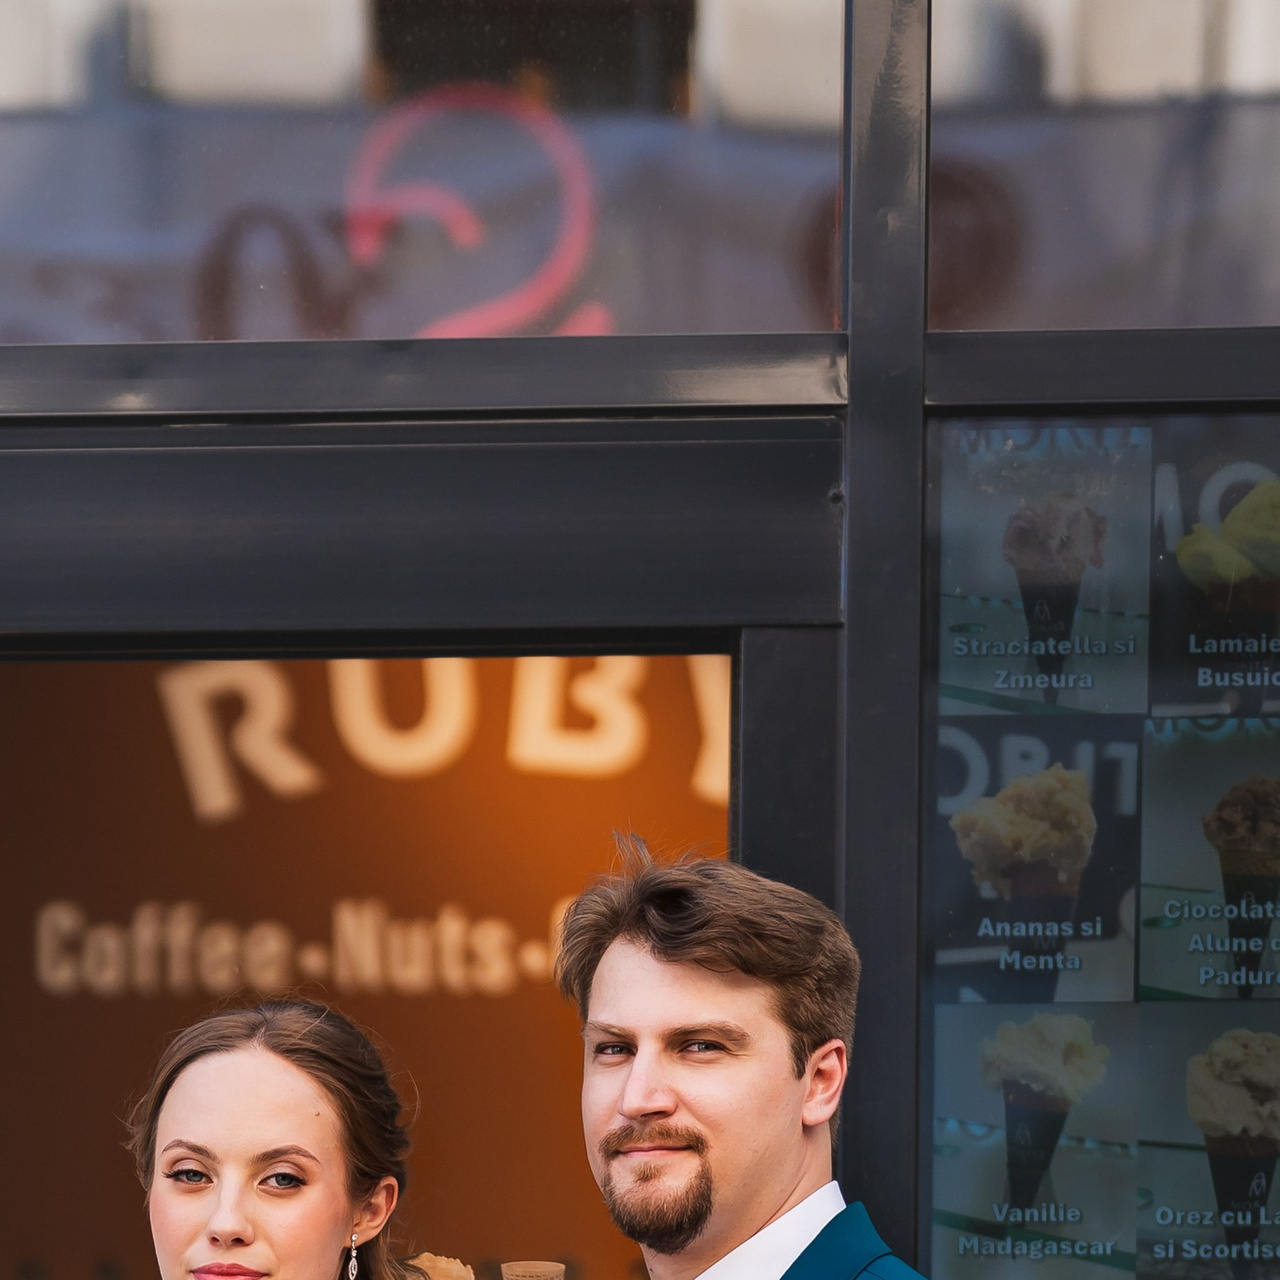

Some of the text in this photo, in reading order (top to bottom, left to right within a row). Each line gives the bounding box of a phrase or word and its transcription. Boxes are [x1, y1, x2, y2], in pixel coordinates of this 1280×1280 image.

[952, 634, 1136, 657] Straciatella si
[994, 669, 1094, 690] Zmeura
[977, 916, 1102, 938] Ananas si
[34, 898, 294, 999] Coffee
[330, 897, 517, 998] Nuts
[1187, 933, 1264, 953] Alune
[998, 950, 1083, 971] Menta
[992, 1202, 1083, 1224] Vanilie
[1155, 1205, 1216, 1226] Orez
[1220, 1210, 1253, 1226] cu
[958, 1235, 1116, 1259] Madagascar
[1153, 1238, 1280, 1259] si Scortis
